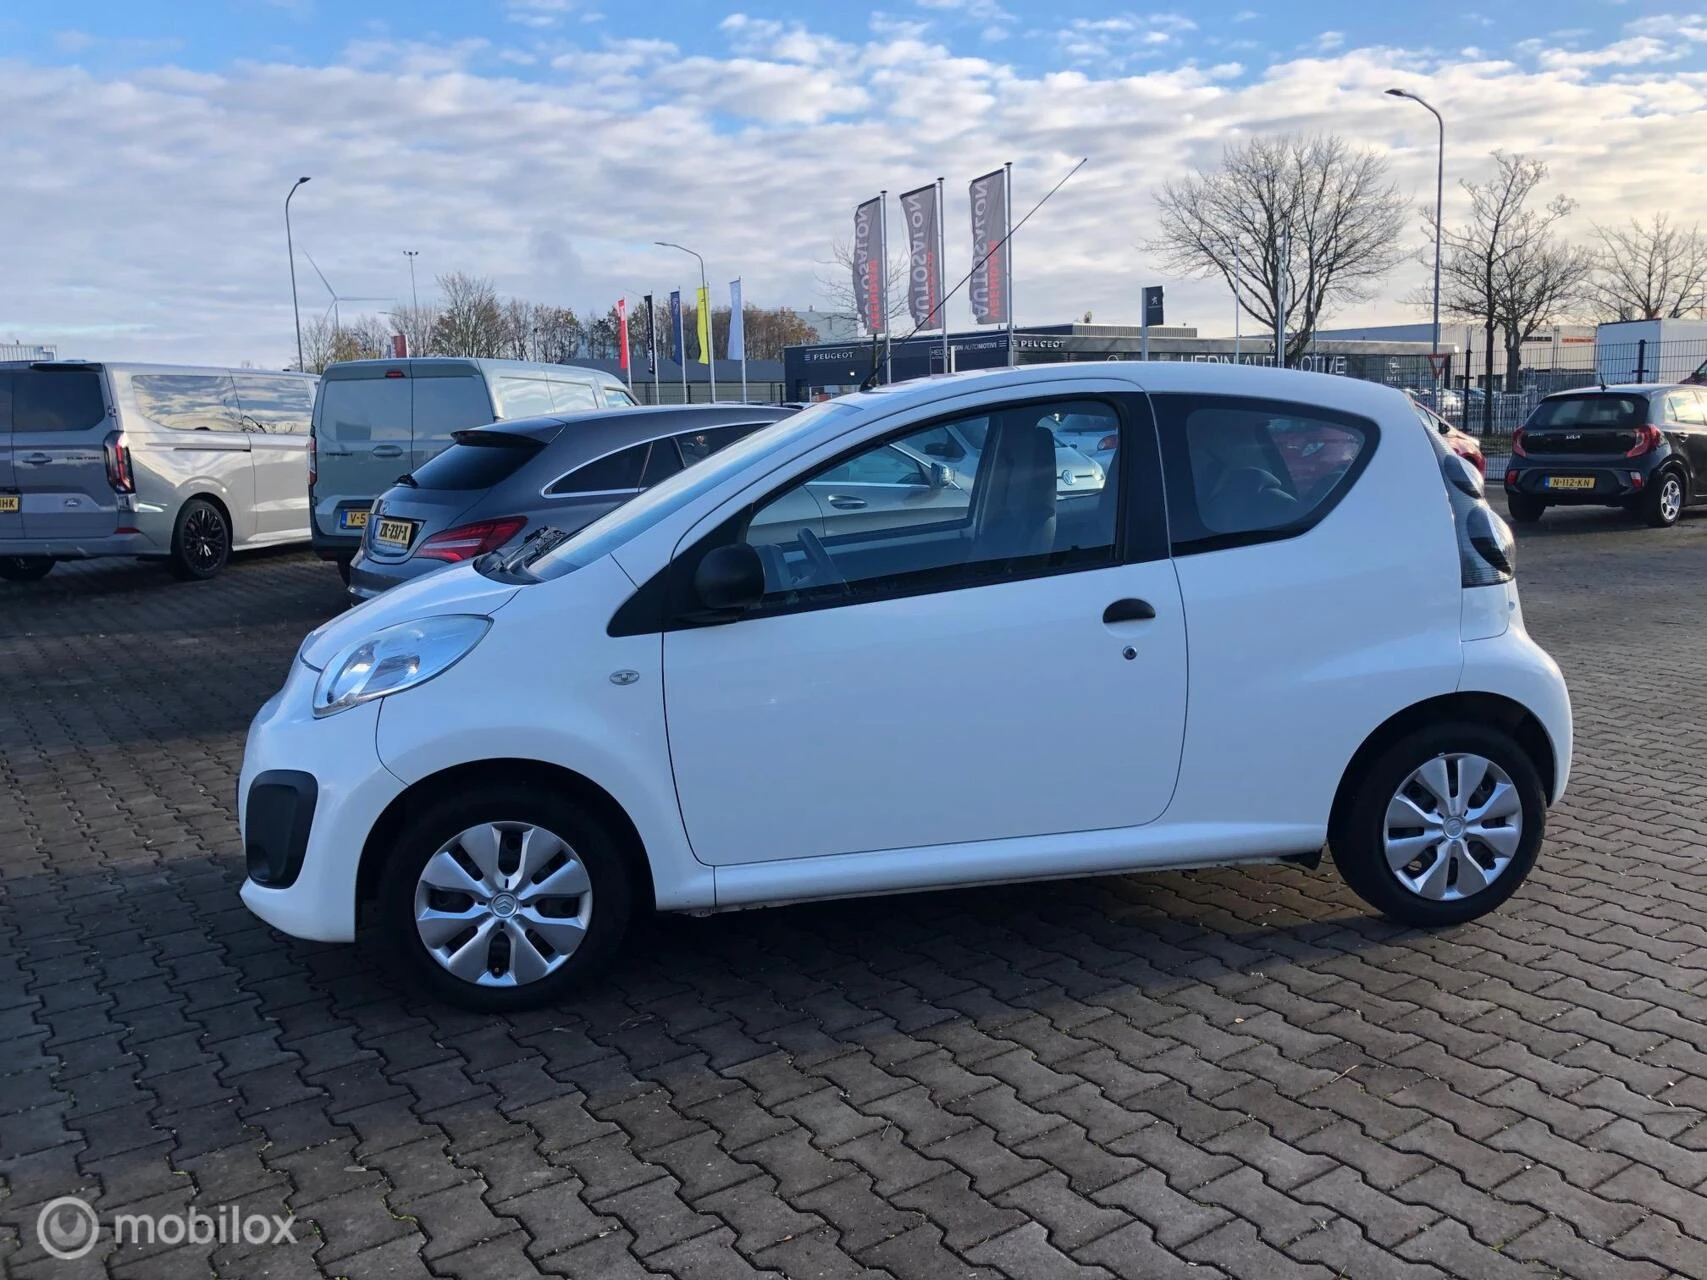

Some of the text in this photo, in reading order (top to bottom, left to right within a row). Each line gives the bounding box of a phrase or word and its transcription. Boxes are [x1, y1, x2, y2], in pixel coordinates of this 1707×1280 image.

[1020, 340, 1066, 349] PEUGEOT
[813, 351, 854, 361] PEUGEOT
[1552, 479, 1590, 487] N-112-KN
